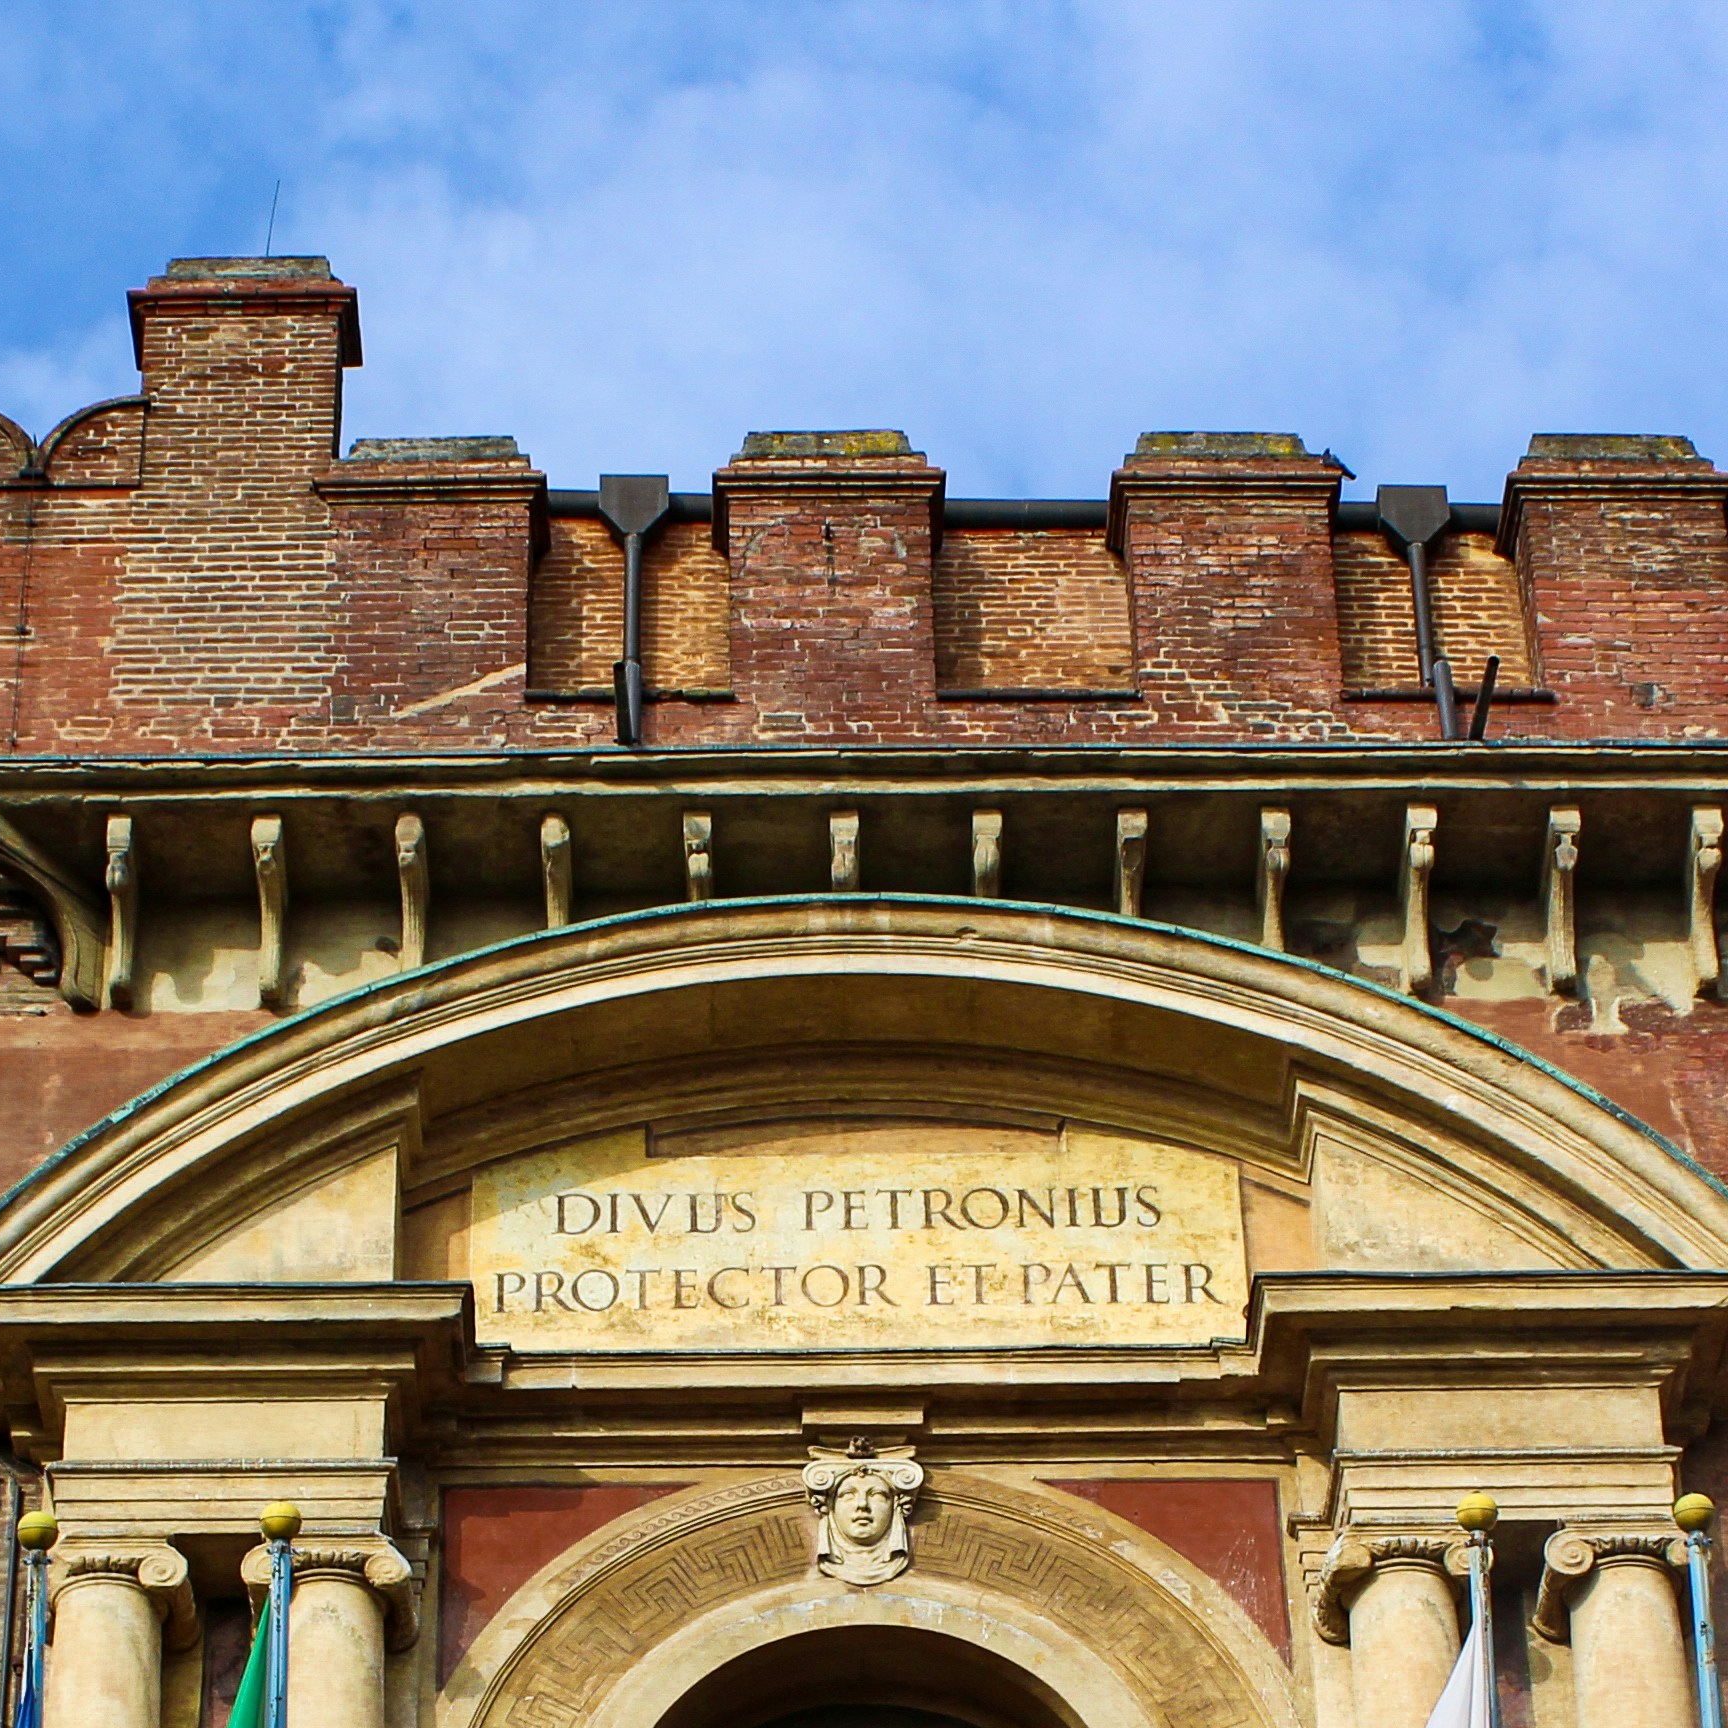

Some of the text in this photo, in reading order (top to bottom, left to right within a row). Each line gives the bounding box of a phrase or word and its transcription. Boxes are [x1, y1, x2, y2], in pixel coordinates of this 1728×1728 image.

[553, 1185, 1164, 1237] DIVUS PETRONIUS
[493, 1261, 1226, 1315] PROTECTOR ET PATER
